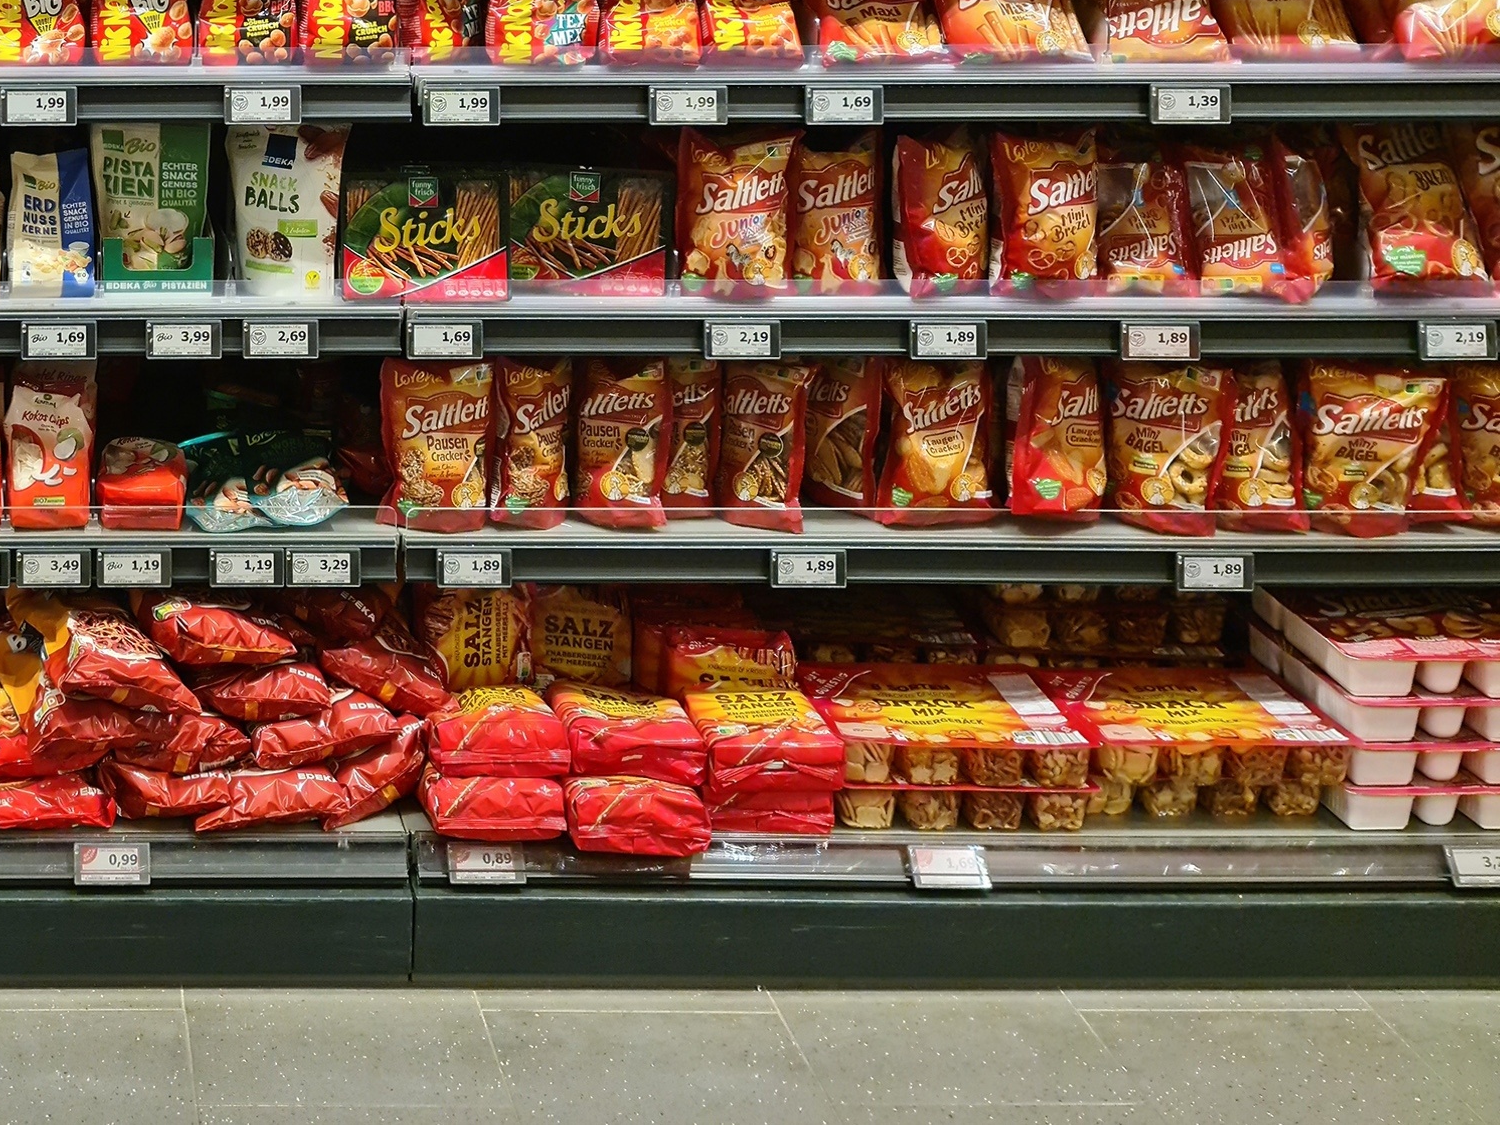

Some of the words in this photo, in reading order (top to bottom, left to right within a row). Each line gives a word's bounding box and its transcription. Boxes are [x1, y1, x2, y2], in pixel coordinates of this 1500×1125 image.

[555, 14, 586, 31] TEX
[552, 30, 583, 46] MEX
[36, 97, 65, 111] 1,99
[458, 97, 488, 111] 1,99
[685, 96, 715, 110] 1,99
[1188, 95, 1219, 109] 1,39
[104, 157, 155, 178] PISTA
[261, 155, 295, 167] EDEKA
[250, 173, 298, 191] SNACK
[24, 195, 55, 212] ERD
[244, 188, 299, 214] BALLS
[23, 211, 58, 225] NUSS
[532, 197, 642, 241] Sticks
[22, 225, 58, 235] KERNE
[374, 206, 482, 252] Sticks
[106, 282, 140, 290] EDEKA
[161, 281, 208, 290] PISTAZIEN
[56, 331, 85, 345] 1,69
[278, 330, 307, 344] 2,69
[739, 331, 769, 345] 2,19
[1158, 332, 1188, 346] 1,89
[1455, 331, 1485, 343] 2,19
[426, 435, 469, 452] Pausen
[431, 449, 464, 462] Cracker
[50, 559, 80, 573] 3,49
[244, 559, 273, 573] 1,19
[472, 559, 500, 573] 1,89
[1213, 563, 1242, 577] 1,89
[544, 614, 614, 638] SALZ
[545, 635, 614, 652] STANGEN
[912, 706, 945, 719] MIX
